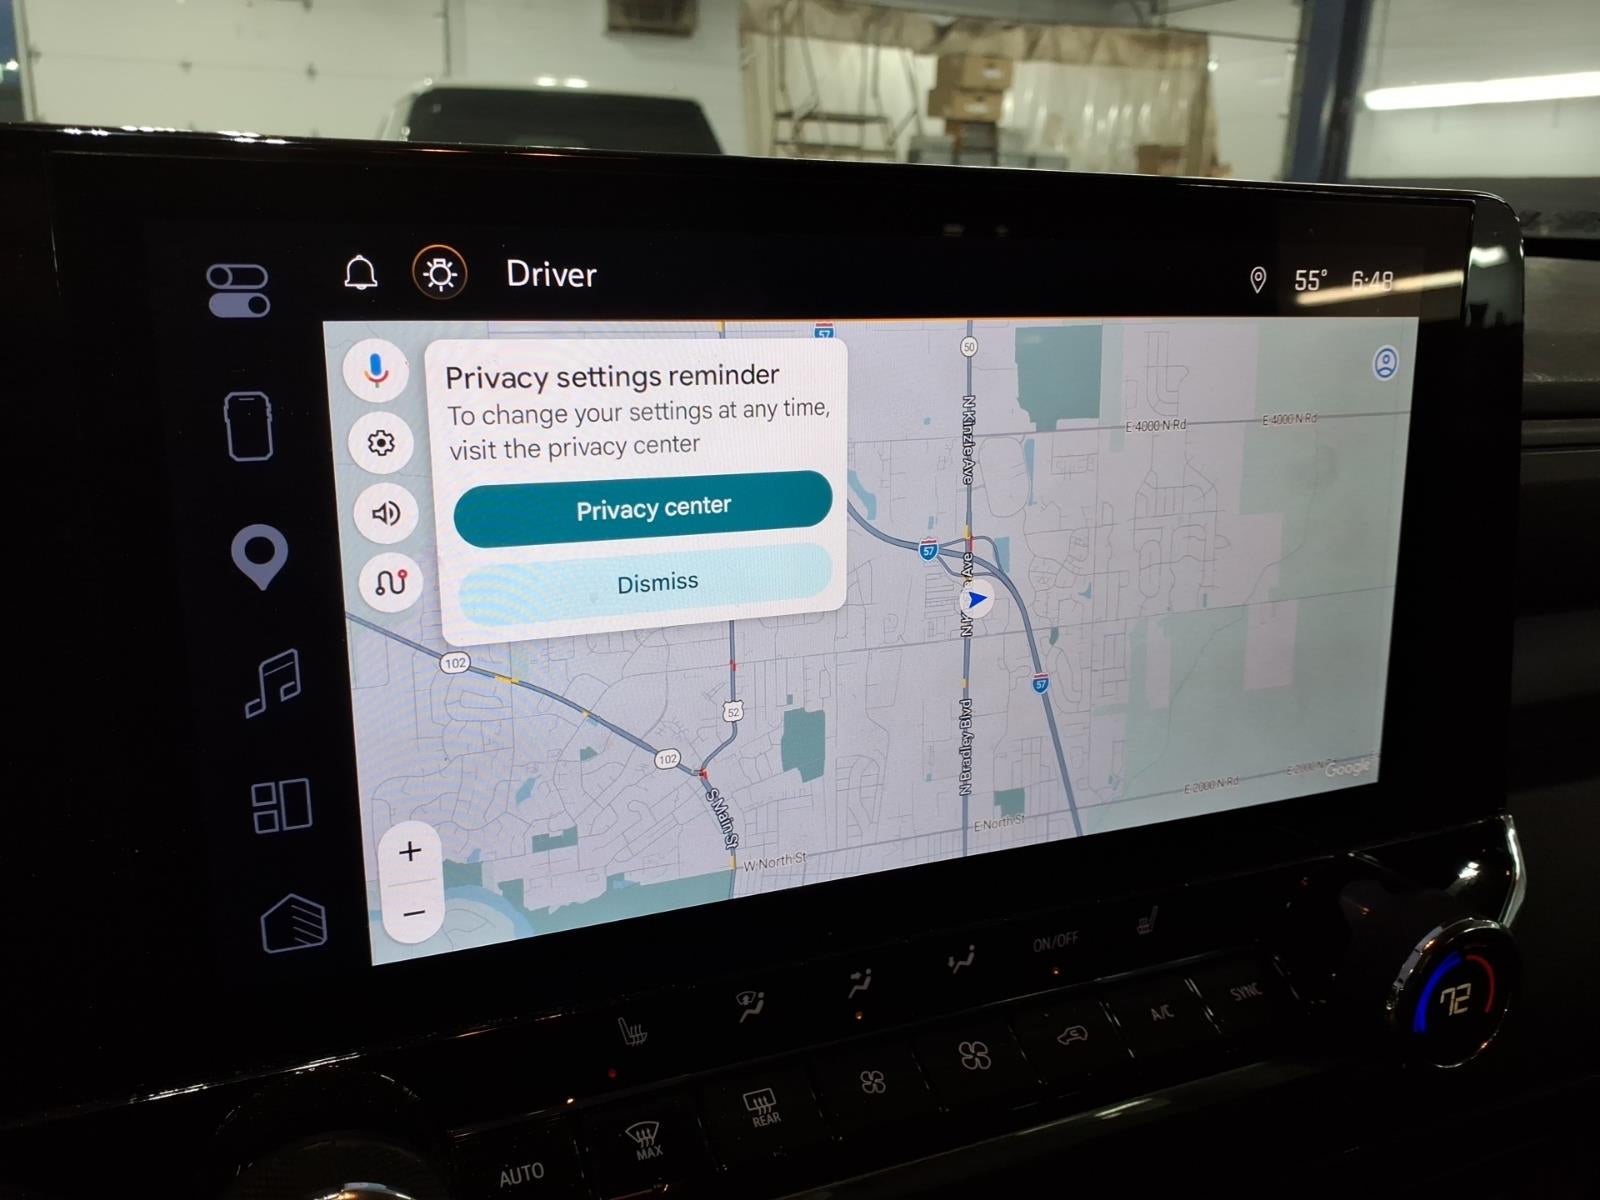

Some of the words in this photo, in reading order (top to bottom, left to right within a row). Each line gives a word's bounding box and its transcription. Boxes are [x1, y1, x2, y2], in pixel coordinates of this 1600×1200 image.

[507, 259, 598, 288] Driver
[1294, 268, 1328, 291] 55°
[1351, 270, 1394, 292] 6:48
[964, 342, 975, 352] 50
[446, 366, 549, 395] Privacy
[557, 364, 662, 393] settings
[669, 363, 780, 386] reminder
[963, 396, 976, 408] N
[447, 405, 475, 426] To
[482, 403, 568, 429] change
[574, 406, 622, 428] your
[629, 400, 713, 425] settings
[718, 401, 737, 419] at
[743, 402, 778, 422] any
[783, 397, 830, 419] time,
[1262, 415, 1269, 426] E
[1295, 413, 1303, 424] N
[1305, 412, 1318, 423] Rd
[963, 410, 976, 457] Kinzie
[1125, 421, 1133, 433] E
[1135, 420, 1159, 432] 4000
[1162, 419, 1170, 430] N
[1173, 417, 1187, 430] Rd
[449, 439, 497, 461] visit
[503, 437, 541, 459] the
[548, 436, 627, 462] privacy
[633, 435, 701, 455] center
[963, 458, 975, 486] Ave
[577, 499, 660, 523] Privacy
[664, 496, 732, 517] center
[923, 546, 935, 556] 57
[961, 552, 973, 578] Ave
[618, 571, 699, 595] Dismiss
[961, 624, 973, 637] N
[445, 657, 467, 669] 102
[1036, 680, 1047, 690] 57
[728, 708, 740, 718] 52
[959, 698, 972, 730] Blvd
[660, 754, 678, 765] 102
[959, 730, 975, 783] Bradley
[1324, 759, 1371, 777] Google
[959, 783, 972, 797] N
[1227, 776, 1239, 786] Rd
[706, 788, 719, 802] S
[711, 797, 735, 835] Main
[974, 820, 982, 833] E
[983, 816, 1013, 831] North
[725, 832, 739, 850] St
[743, 860, 756, 873] W
[759, 854, 790, 870] North
[795, 852, 807, 864] St
[1033, 930, 1080, 952] ON/OFF
[1230, 981, 1264, 1001] SYNC
[1440, 983, 1472, 1016] 72
[1151, 1003, 1175, 1021] A/C
[752, 1111, 782, 1128] REAR
[636, 1144, 664, 1161] MAX
[500, 1161, 545, 1189] AUTO
